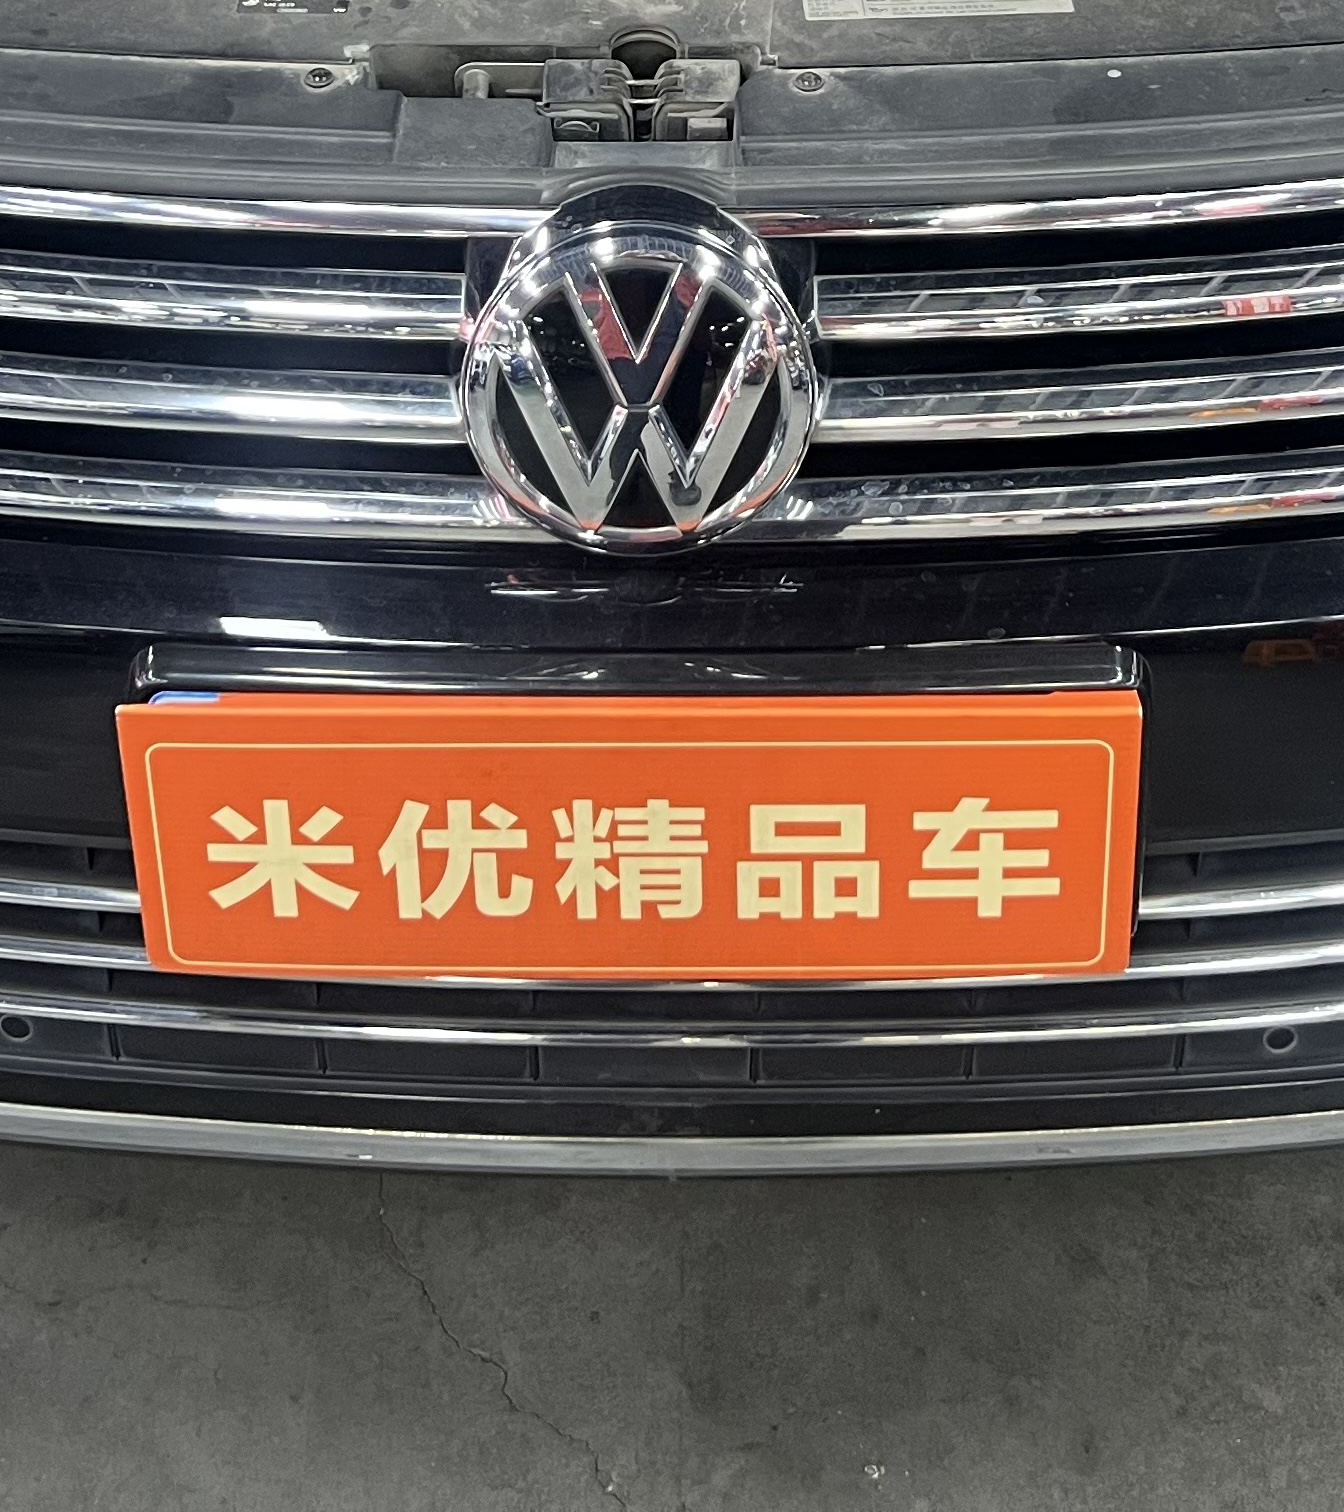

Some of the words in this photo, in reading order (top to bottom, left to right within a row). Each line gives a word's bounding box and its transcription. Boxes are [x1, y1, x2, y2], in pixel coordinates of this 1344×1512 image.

[206, 796, 1062, 921] 米优精品车
